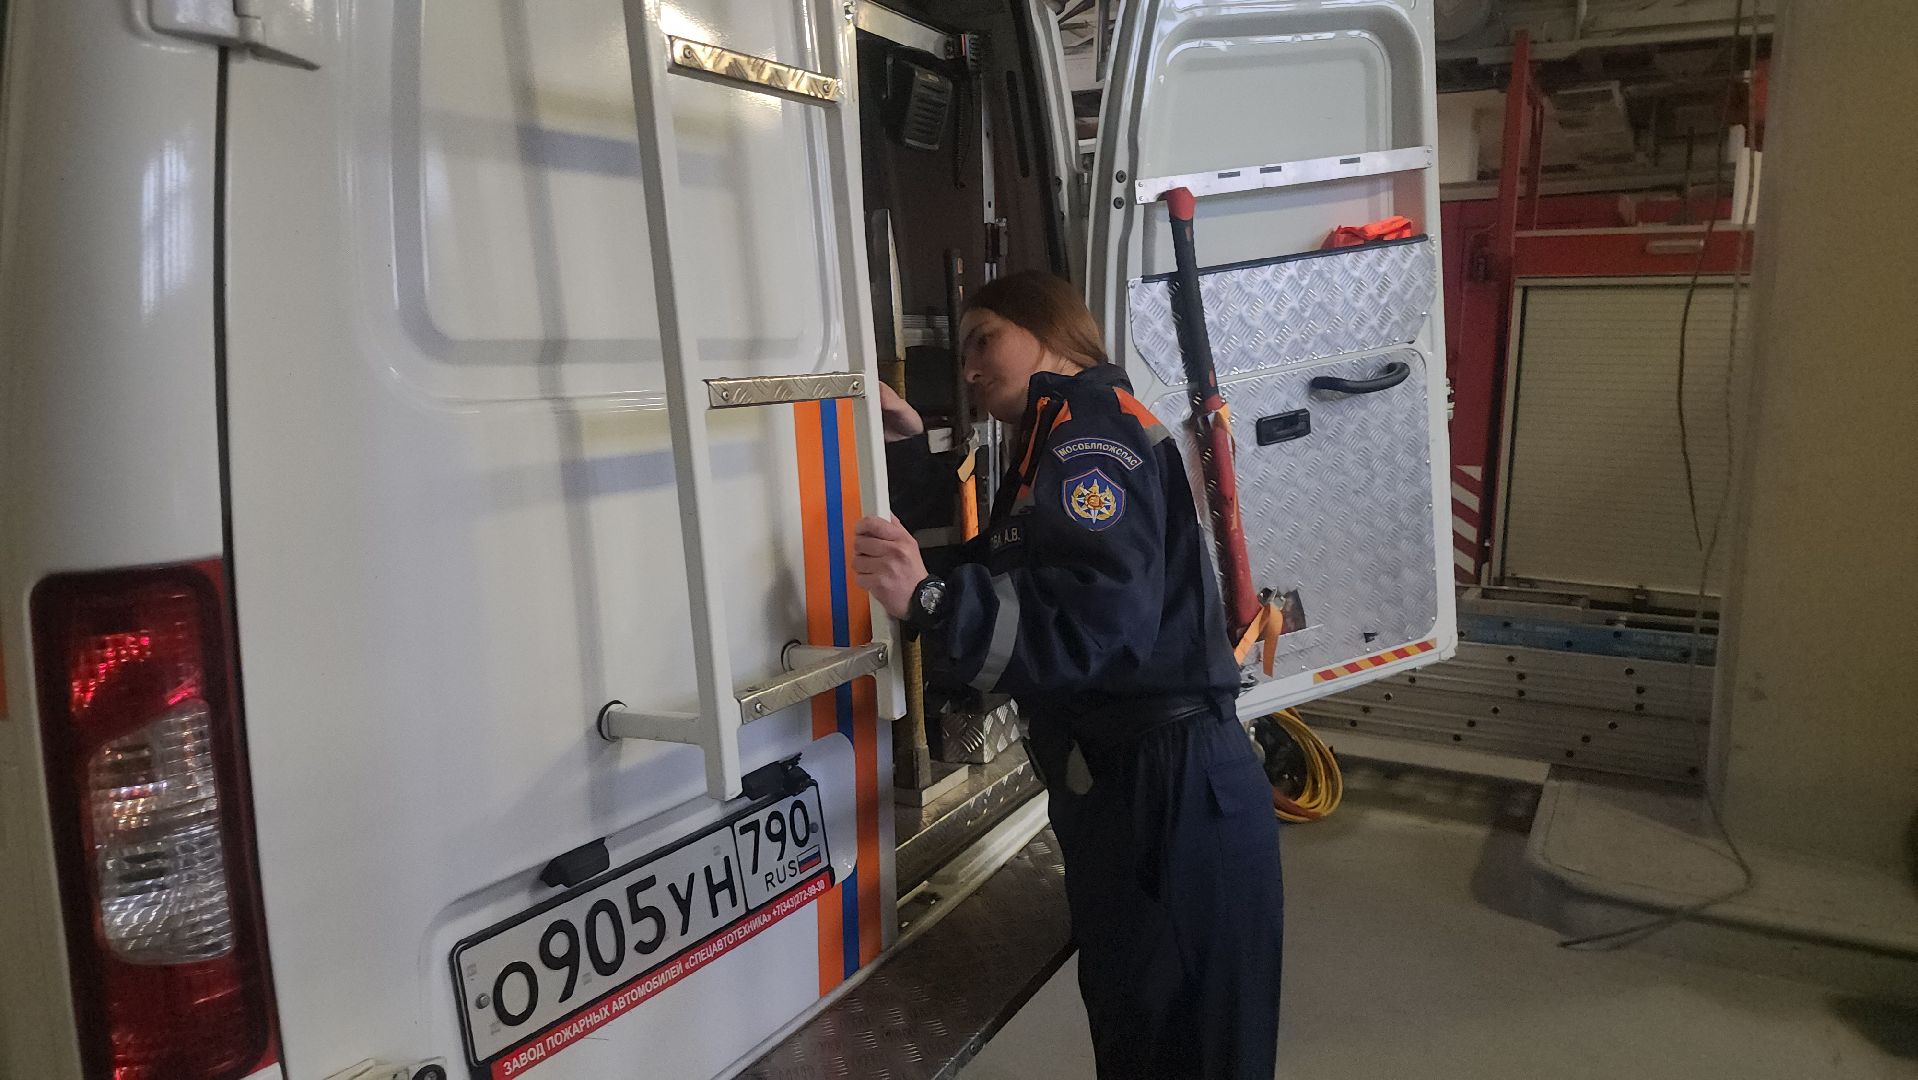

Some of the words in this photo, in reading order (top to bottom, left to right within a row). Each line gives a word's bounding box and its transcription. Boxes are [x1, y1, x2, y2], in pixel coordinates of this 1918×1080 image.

[1058, 442, 1138, 466] МОСОБЛПОЖСПАС
[492, 856, 738, 1026] О905УН
[739, 799, 810, 876] 790
[765, 860, 798, 892] RUS
[503, 1042, 546, 1076] ЗАВОД
[546, 1004, 610, 1051] ПОЖАРНЫХ
[612, 960, 684, 1014] АВТОМОБИЛЕЙ
[685, 913, 772, 970] «СПЕЦАВТОТЕХНИКА»
